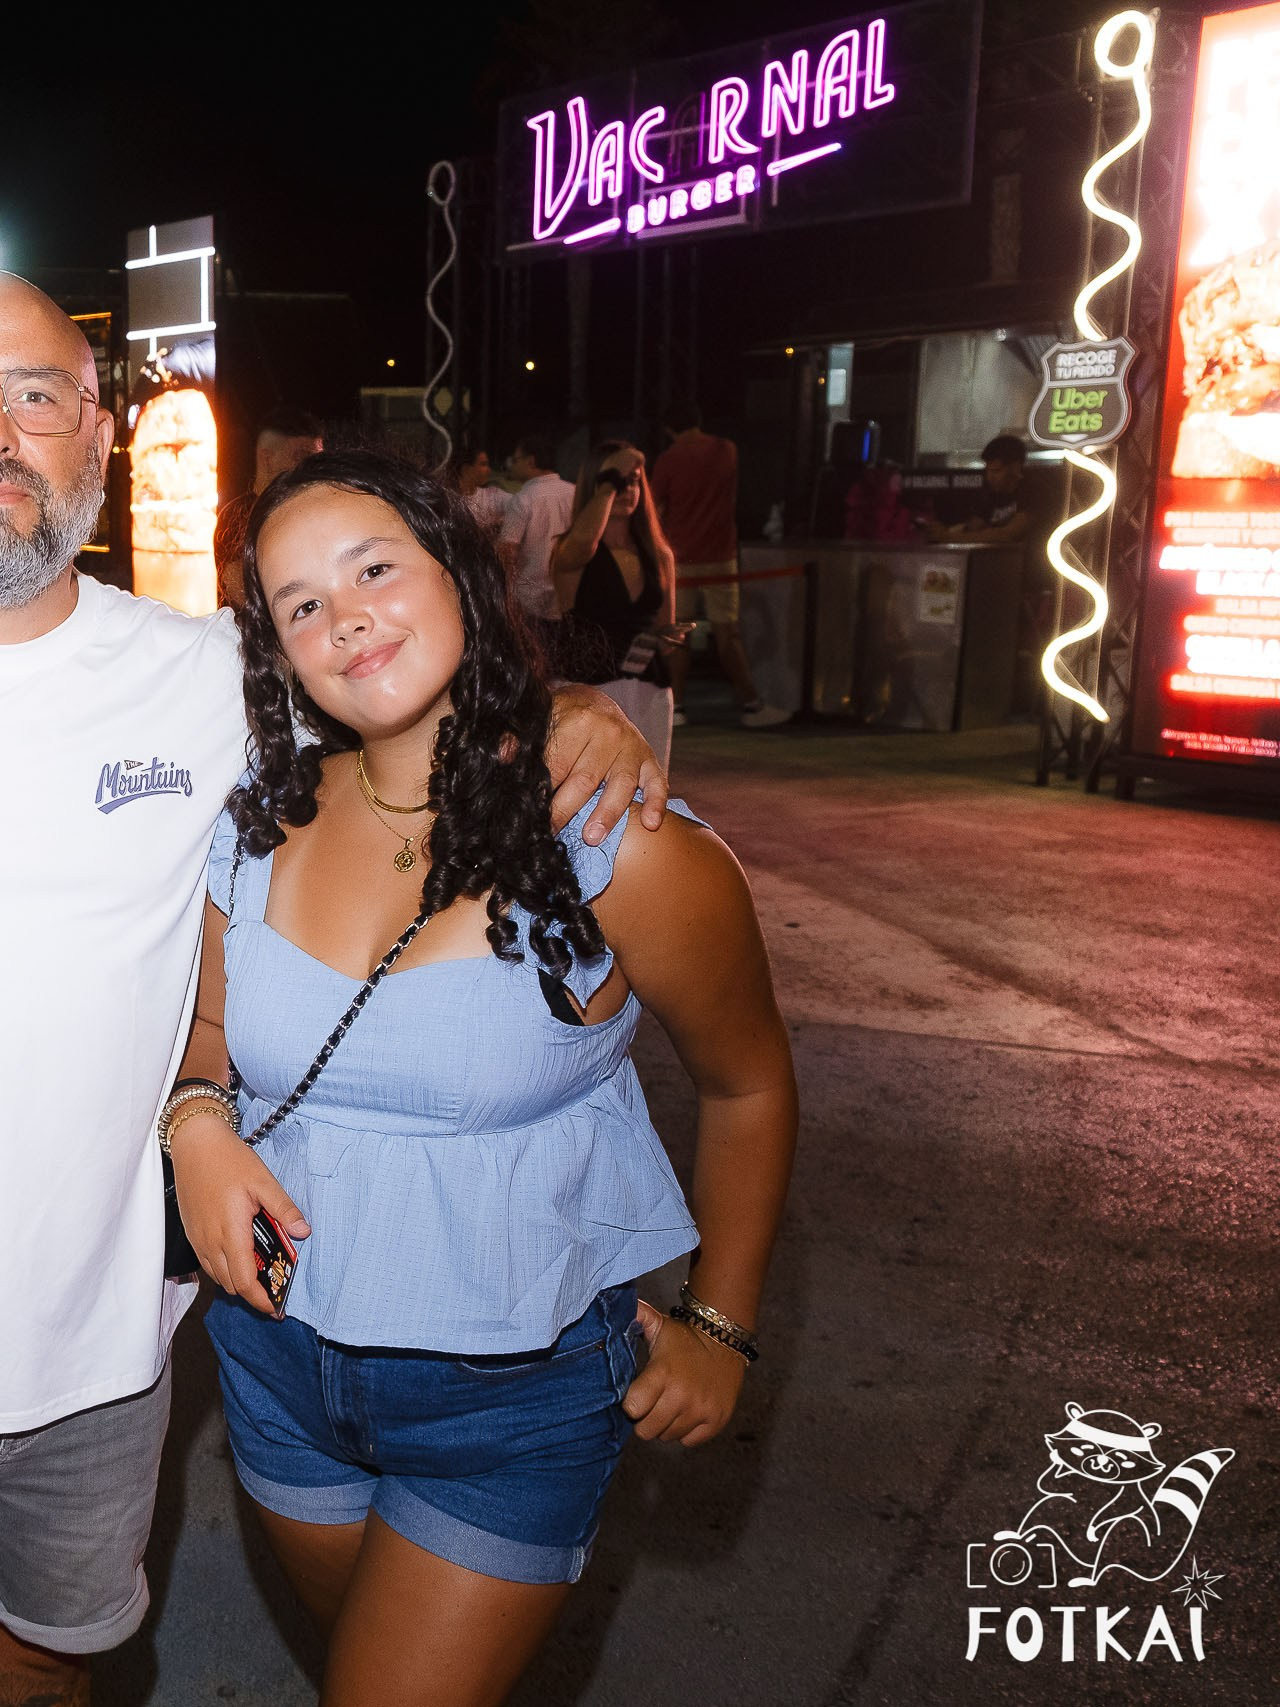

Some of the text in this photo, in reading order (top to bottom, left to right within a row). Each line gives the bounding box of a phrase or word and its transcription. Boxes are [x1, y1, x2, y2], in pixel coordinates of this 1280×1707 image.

[626, 164, 756, 234] BURGER
[1056, 350, 1117, 368] RECOGE
[1055, 364, 1115, 379] TU PEDIDO
[1052, 387, 1108, 411] Uber
[1048, 410, 1103, 433] Eats
[95, 756, 193, 804] Mountains
